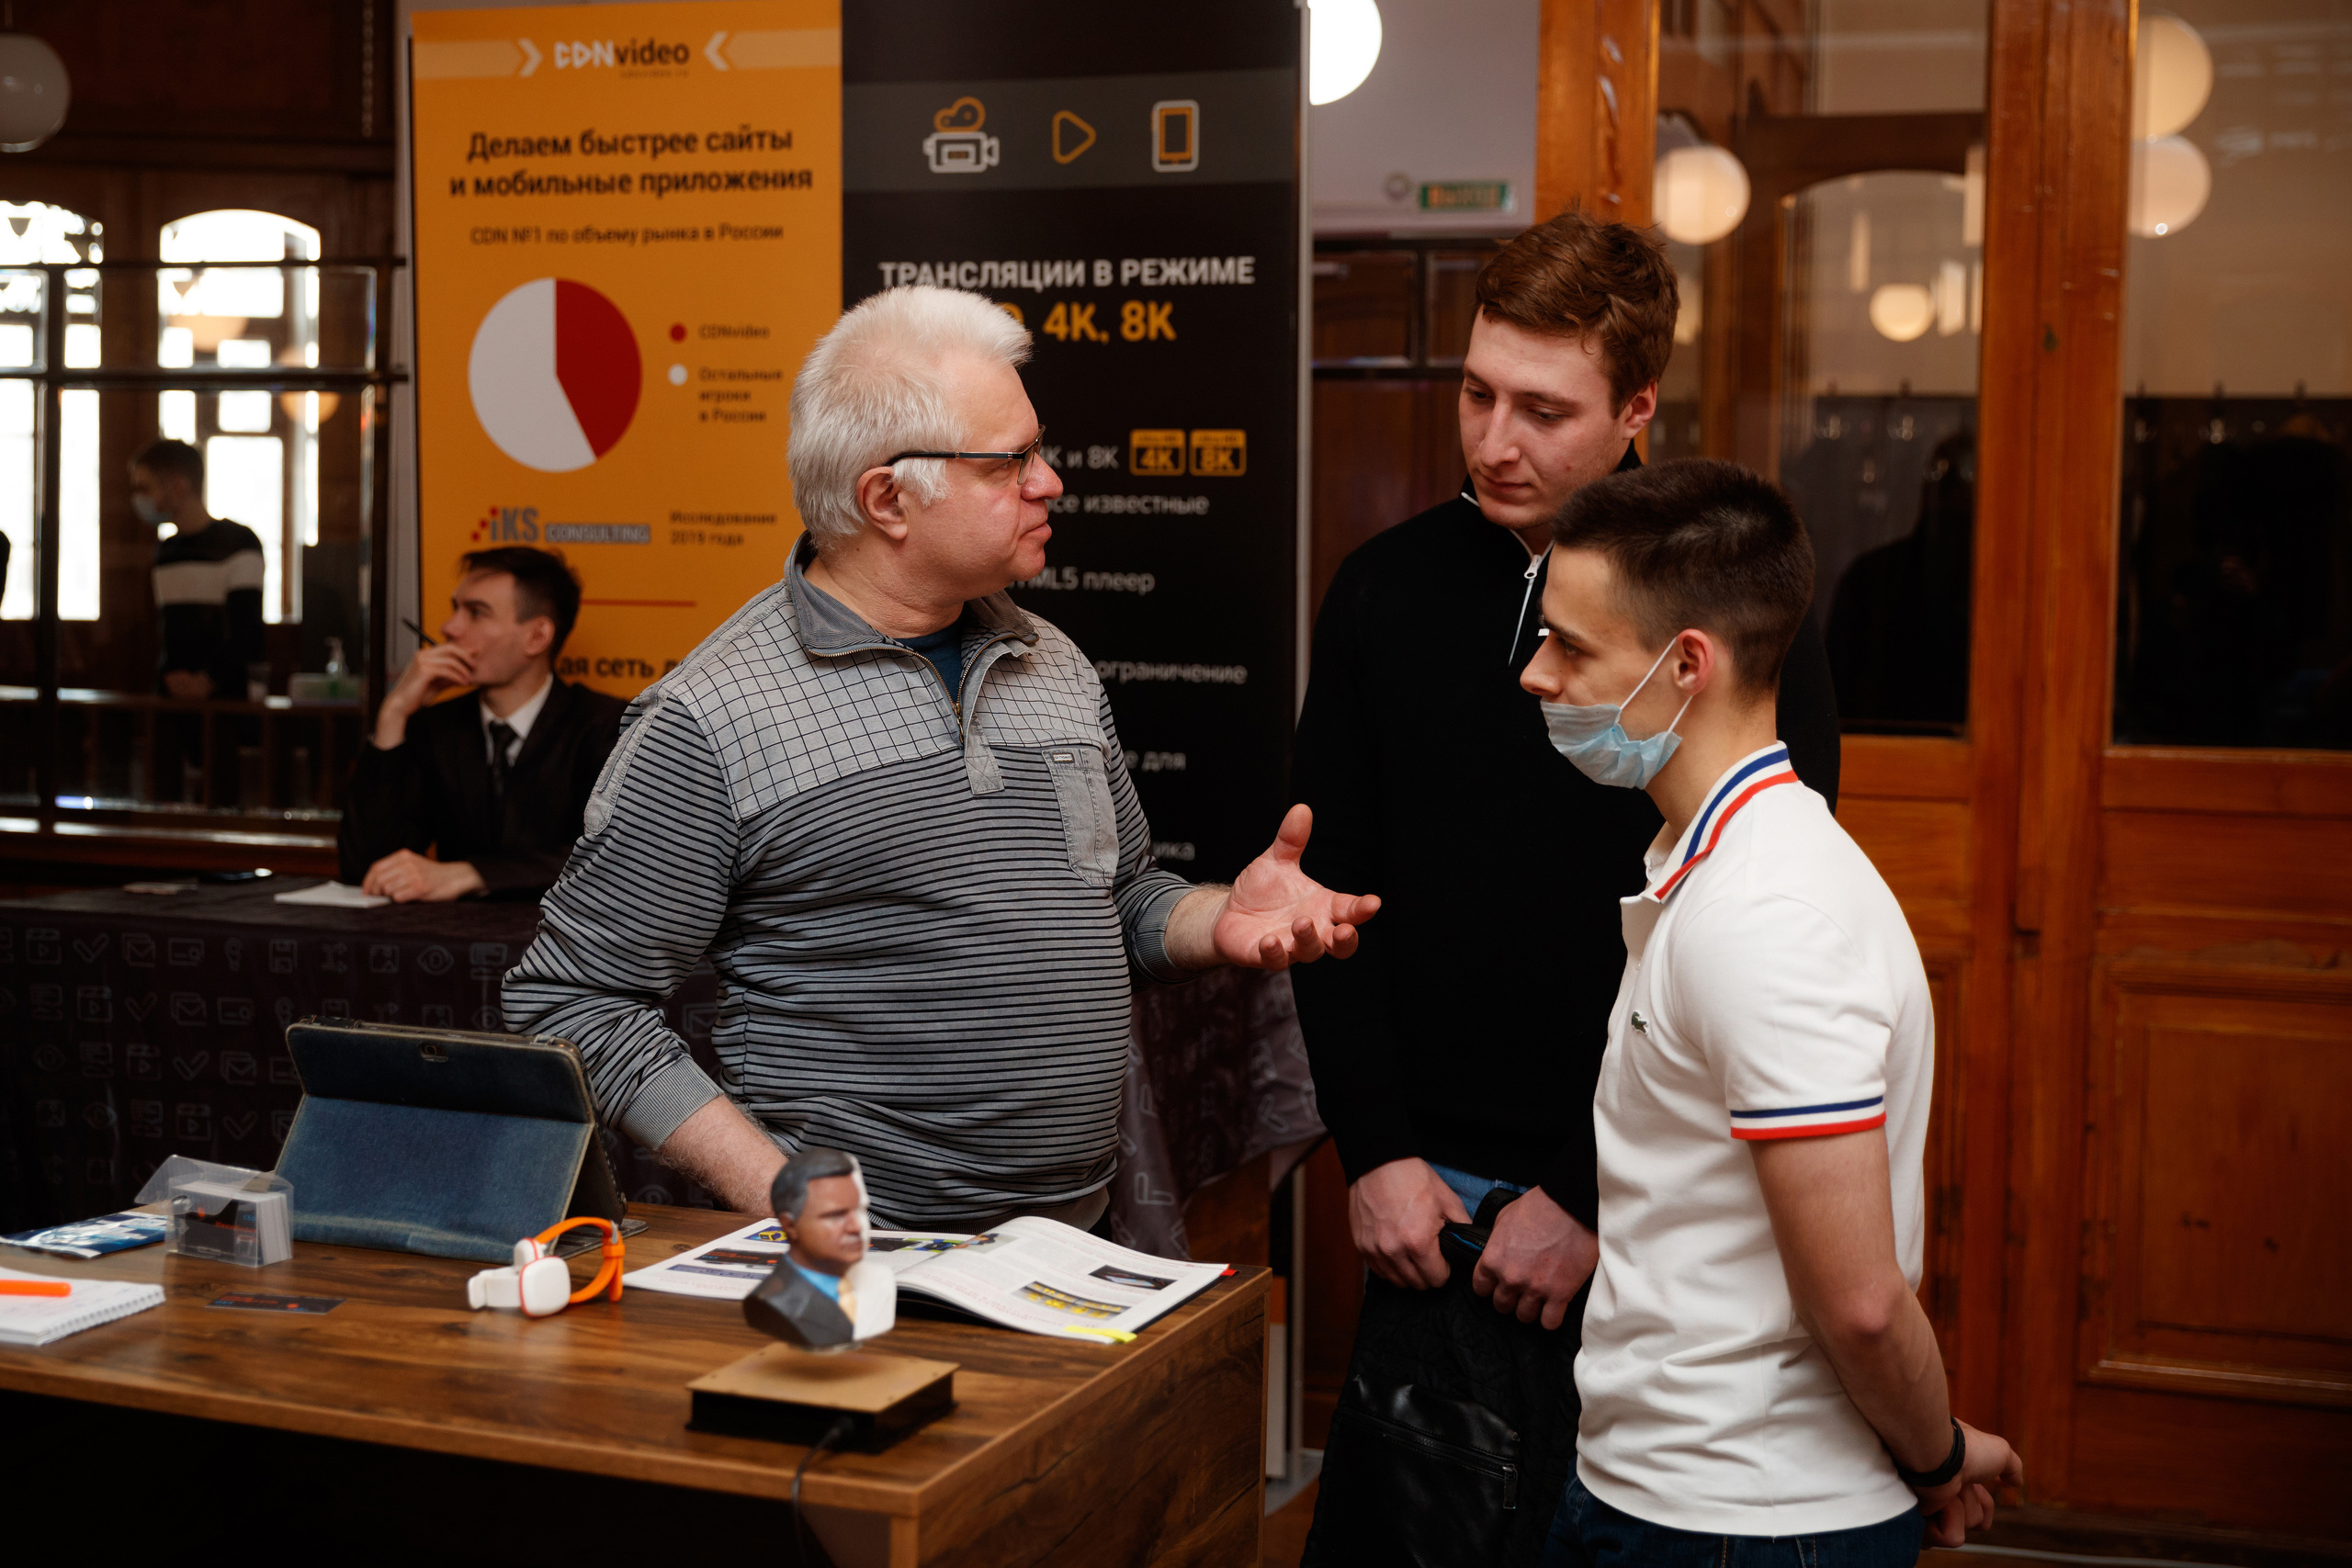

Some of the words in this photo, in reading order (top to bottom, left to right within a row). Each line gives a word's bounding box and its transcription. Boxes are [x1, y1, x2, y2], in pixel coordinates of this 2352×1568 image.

[554, 38, 689, 69] CDNvideo
[468, 131, 571, 163] Делаем
[579, 129, 697, 160] быстрее
[706, 124, 793, 152] сайты
[450, 176, 466, 197] и
[474, 169, 632, 196] мобильные
[639, 168, 813, 198] приложения
[470, 227, 508, 244] CDN
[512, 226, 542, 243] №1
[547, 228, 568, 243] по
[572, 224, 638, 246] объему
[644, 226, 699, 245] рынка
[704, 227, 714, 240] в
[719, 223, 784, 241] России
[879, 260, 1085, 291] ТРАНСЛЯЦИИ
[1094, 258, 1114, 288] В
[1120, 256, 1255, 287] РЕЖИМЕ
[1043, 301, 1110, 344] 4K,
[1120, 299, 1177, 342] 8K
[699, 367, 783, 382] Остальные
[699, 391, 751, 403] игроки
[700, 411, 708, 422] в
[713, 408, 766, 422] России
[1067, 450, 1082, 469] и
[1084, 494, 1209, 516] известные
[670, 511, 776, 526] Исследование
[710, 533, 744, 547] года
[1083, 572, 1155, 596] плеер
[596, 657, 655, 678] сеть
[1095, 660, 1248, 685] ограничение
[1142, 751, 1186, 773] для
